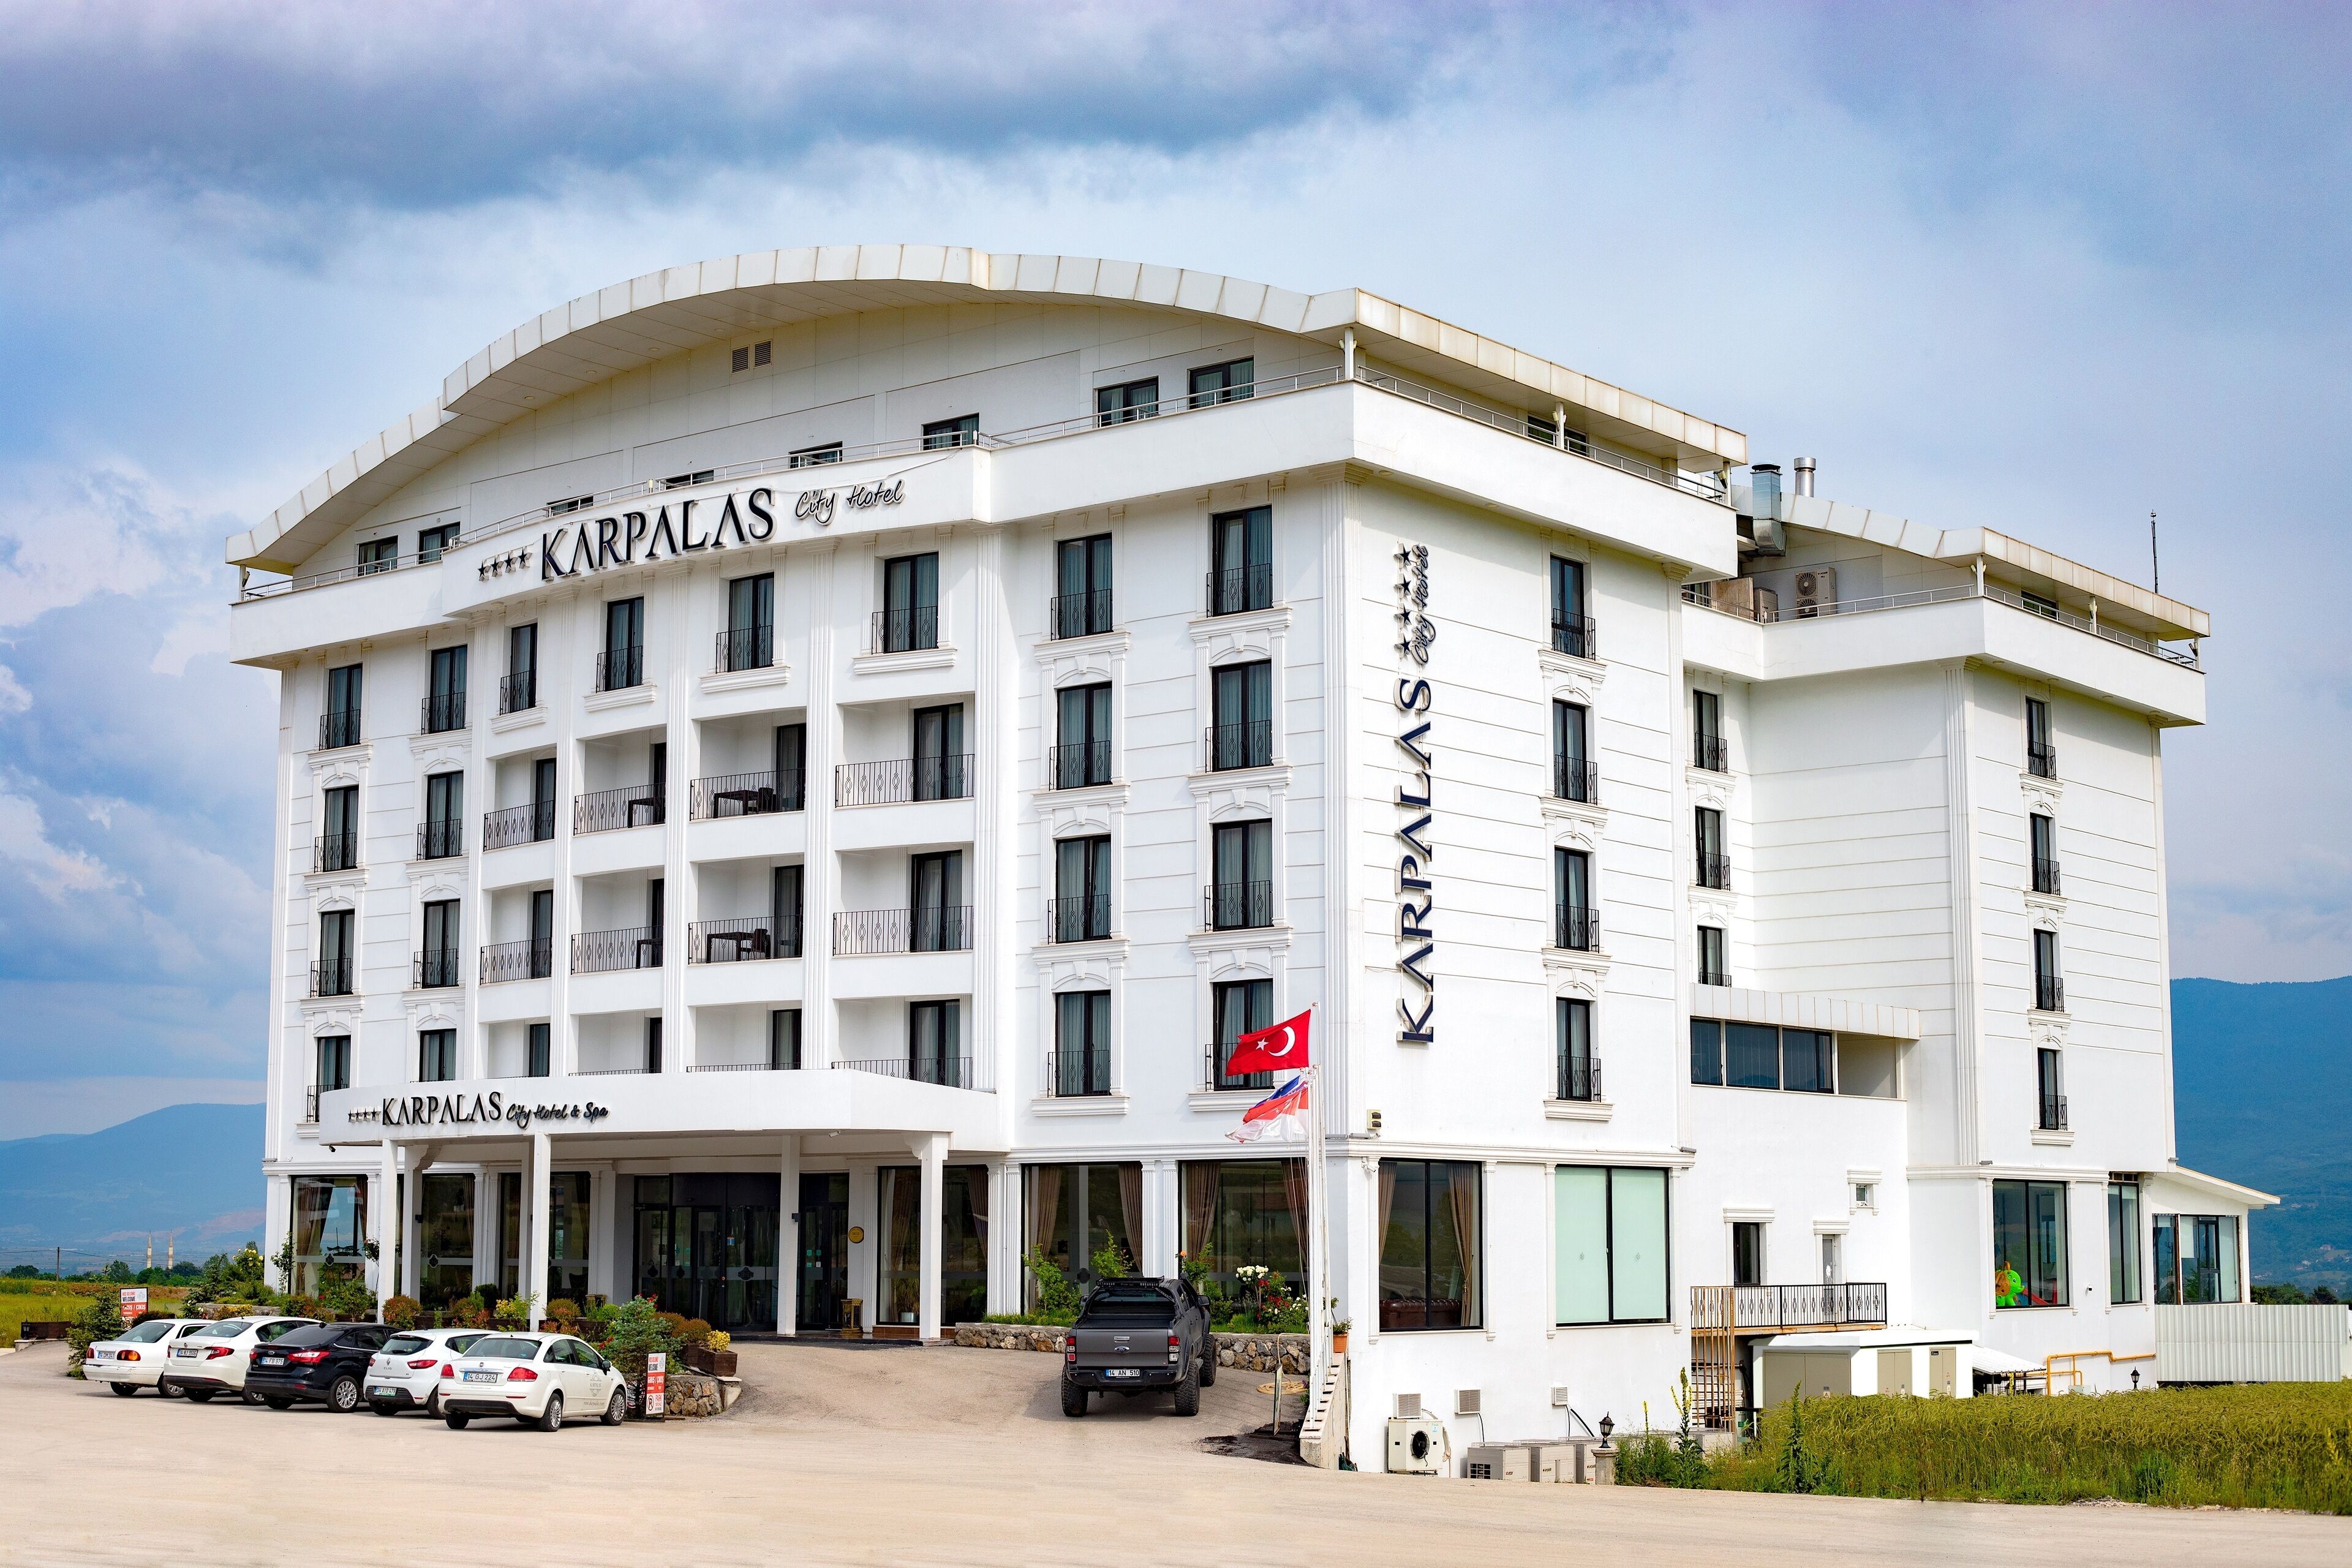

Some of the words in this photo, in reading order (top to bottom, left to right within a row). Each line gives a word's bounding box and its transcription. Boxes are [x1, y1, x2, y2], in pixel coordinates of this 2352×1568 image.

[541, 487, 776, 581] KARPALAS
[795, 489, 840, 526] City
[846, 478, 907, 508] Hotel
[1411, 544, 1429, 611] Hotel
[1411, 613, 1436, 665] City
[1394, 677, 1434, 1044] KARPALAS
[382, 1091, 504, 1126] KARPALAS
[506, 1103, 532, 1130] City
[533, 1103, 569, 1120] Hotel
[570, 1104, 581, 1118] &
[583, 1101, 610, 1123] Spa
